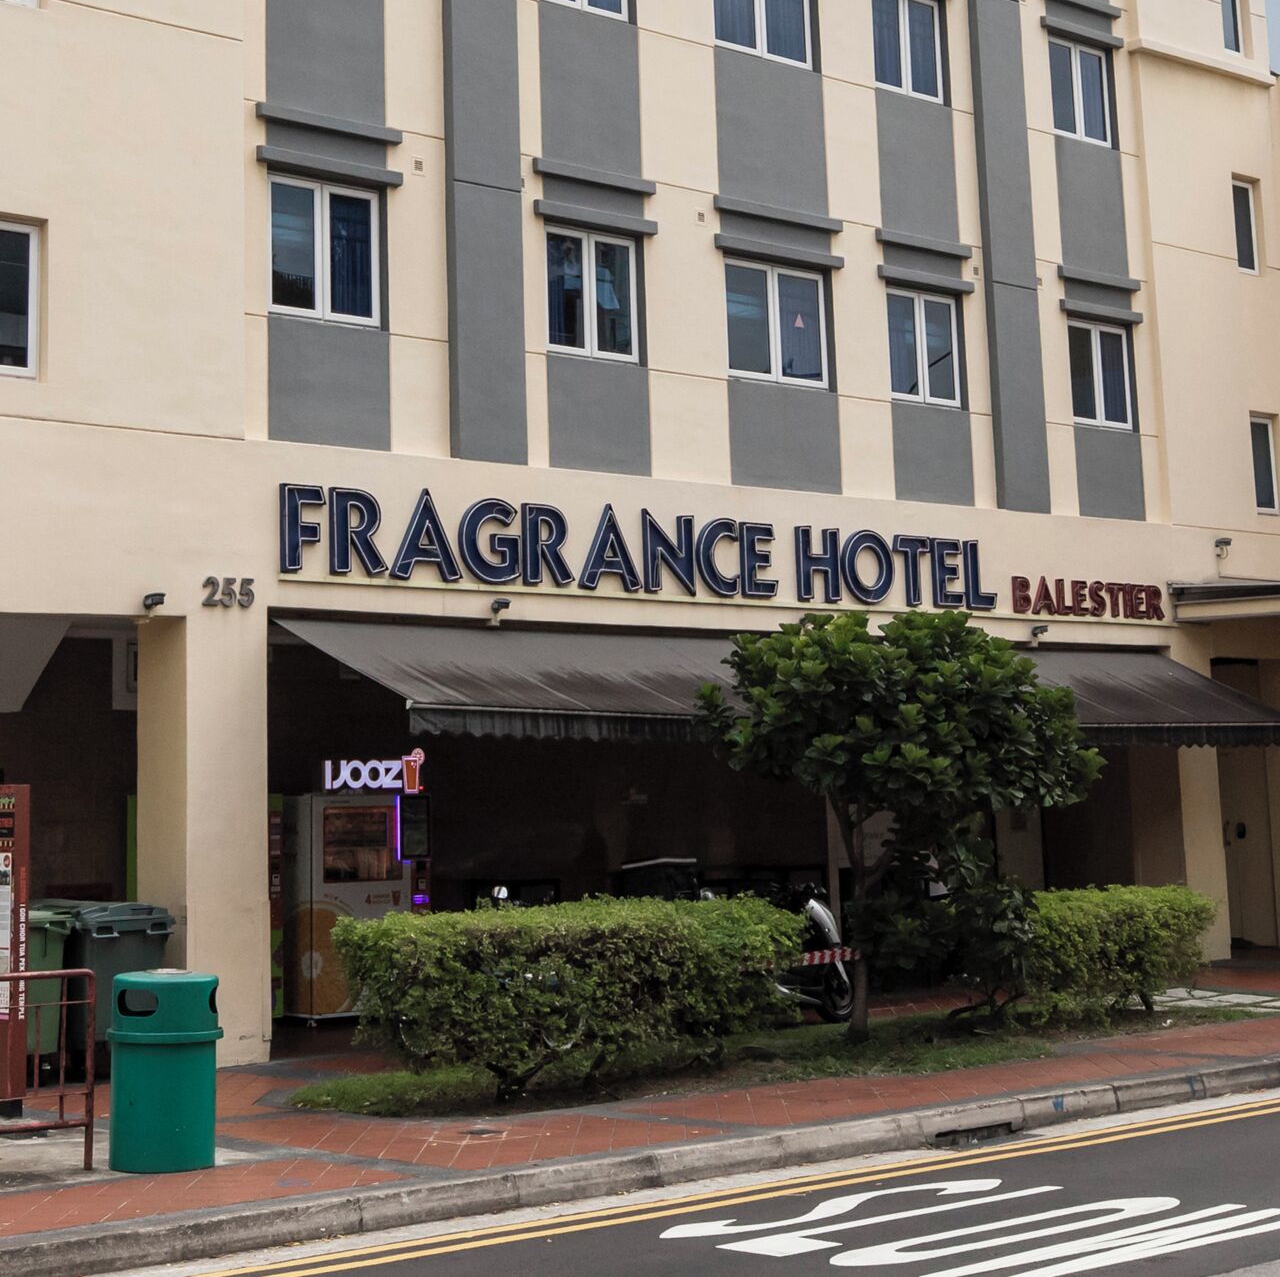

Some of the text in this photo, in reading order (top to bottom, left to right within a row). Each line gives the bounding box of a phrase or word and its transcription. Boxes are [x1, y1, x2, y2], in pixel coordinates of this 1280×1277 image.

[201, 576, 255, 608] 255
[278, 483, 1166, 620] FRAGRANCE HOTEL BALESTIER
